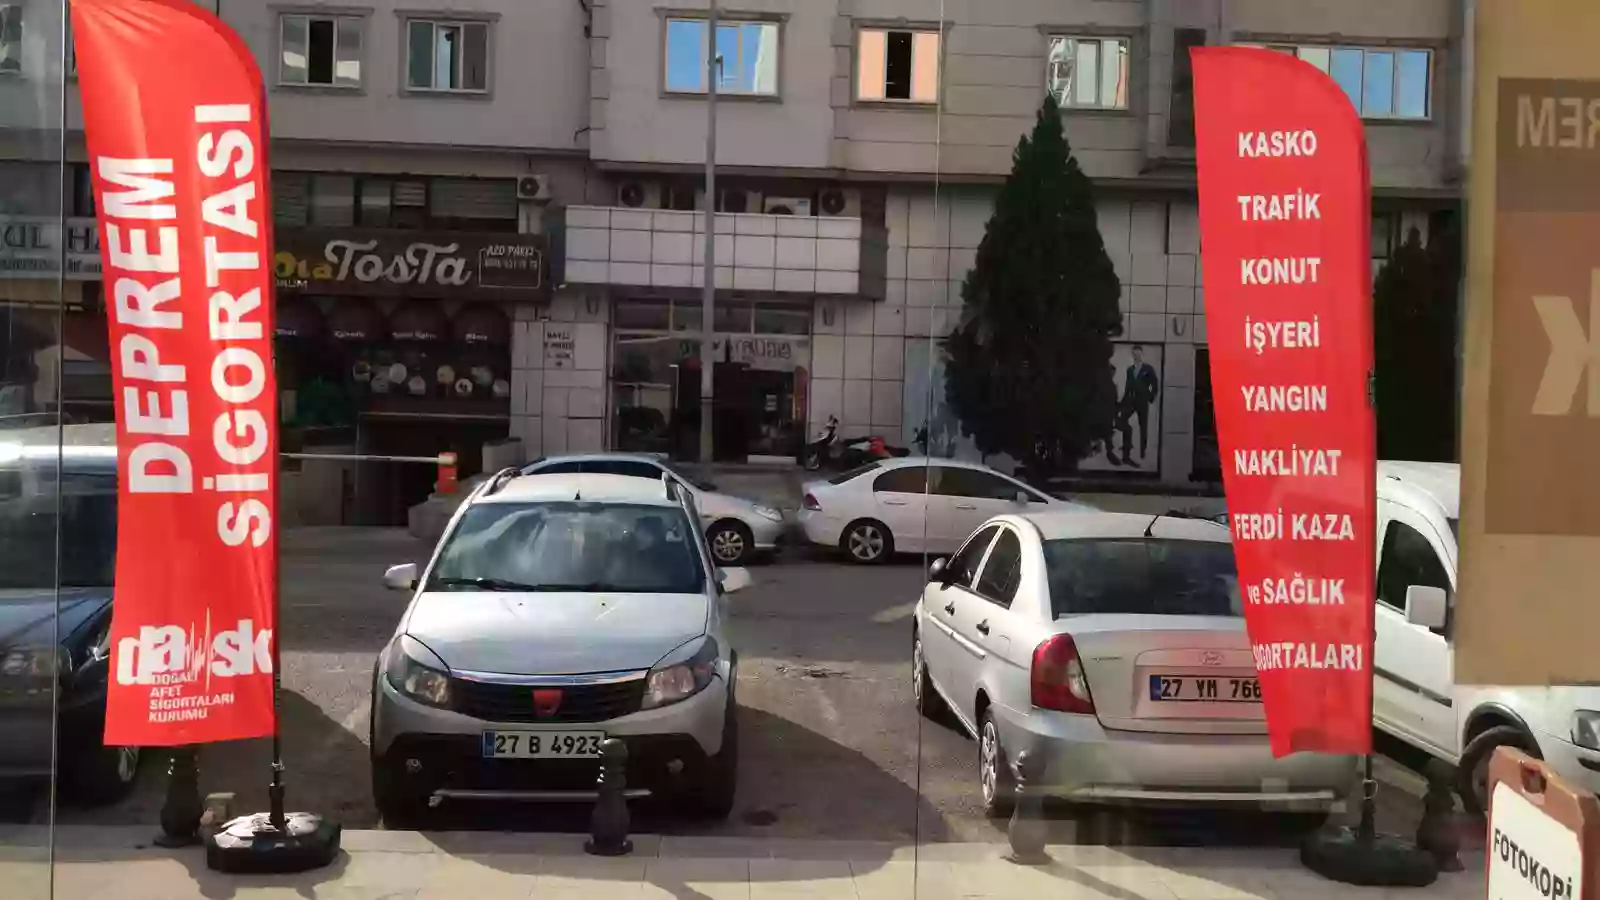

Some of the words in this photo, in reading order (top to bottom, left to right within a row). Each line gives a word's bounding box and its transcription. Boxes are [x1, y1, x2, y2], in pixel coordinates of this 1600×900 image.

[1238, 130, 1318, 158] KASKO
[1237, 187, 1321, 221] TRAFİK
[1240, 256, 1321, 285] KONUT
[97, 155, 194, 495] DEPREM
[194, 103, 272, 549] SİGORTASI
[1245, 315, 1320, 355] İŞYERİ
[1241, 385, 1327, 412] YANGIN
[1234, 444, 1342, 476] NAKLİYAT
[1234, 508, 1283, 541] FERDİ
[1291, 514, 1355, 541] KAZA
[1262, 572, 1345, 605] SAĞLIK
[150, 684, 184, 698] AFET
[150, 693, 235, 710] SİGORTALARI
[1161, 679, 1183, 698] 27
[1196, 679, 1218, 698] YM
[149, 708, 208, 723] KURUMU
[495, 735, 519, 754] 27
[529, 736, 540, 754] B
[550, 735, 600, 755] 4923
